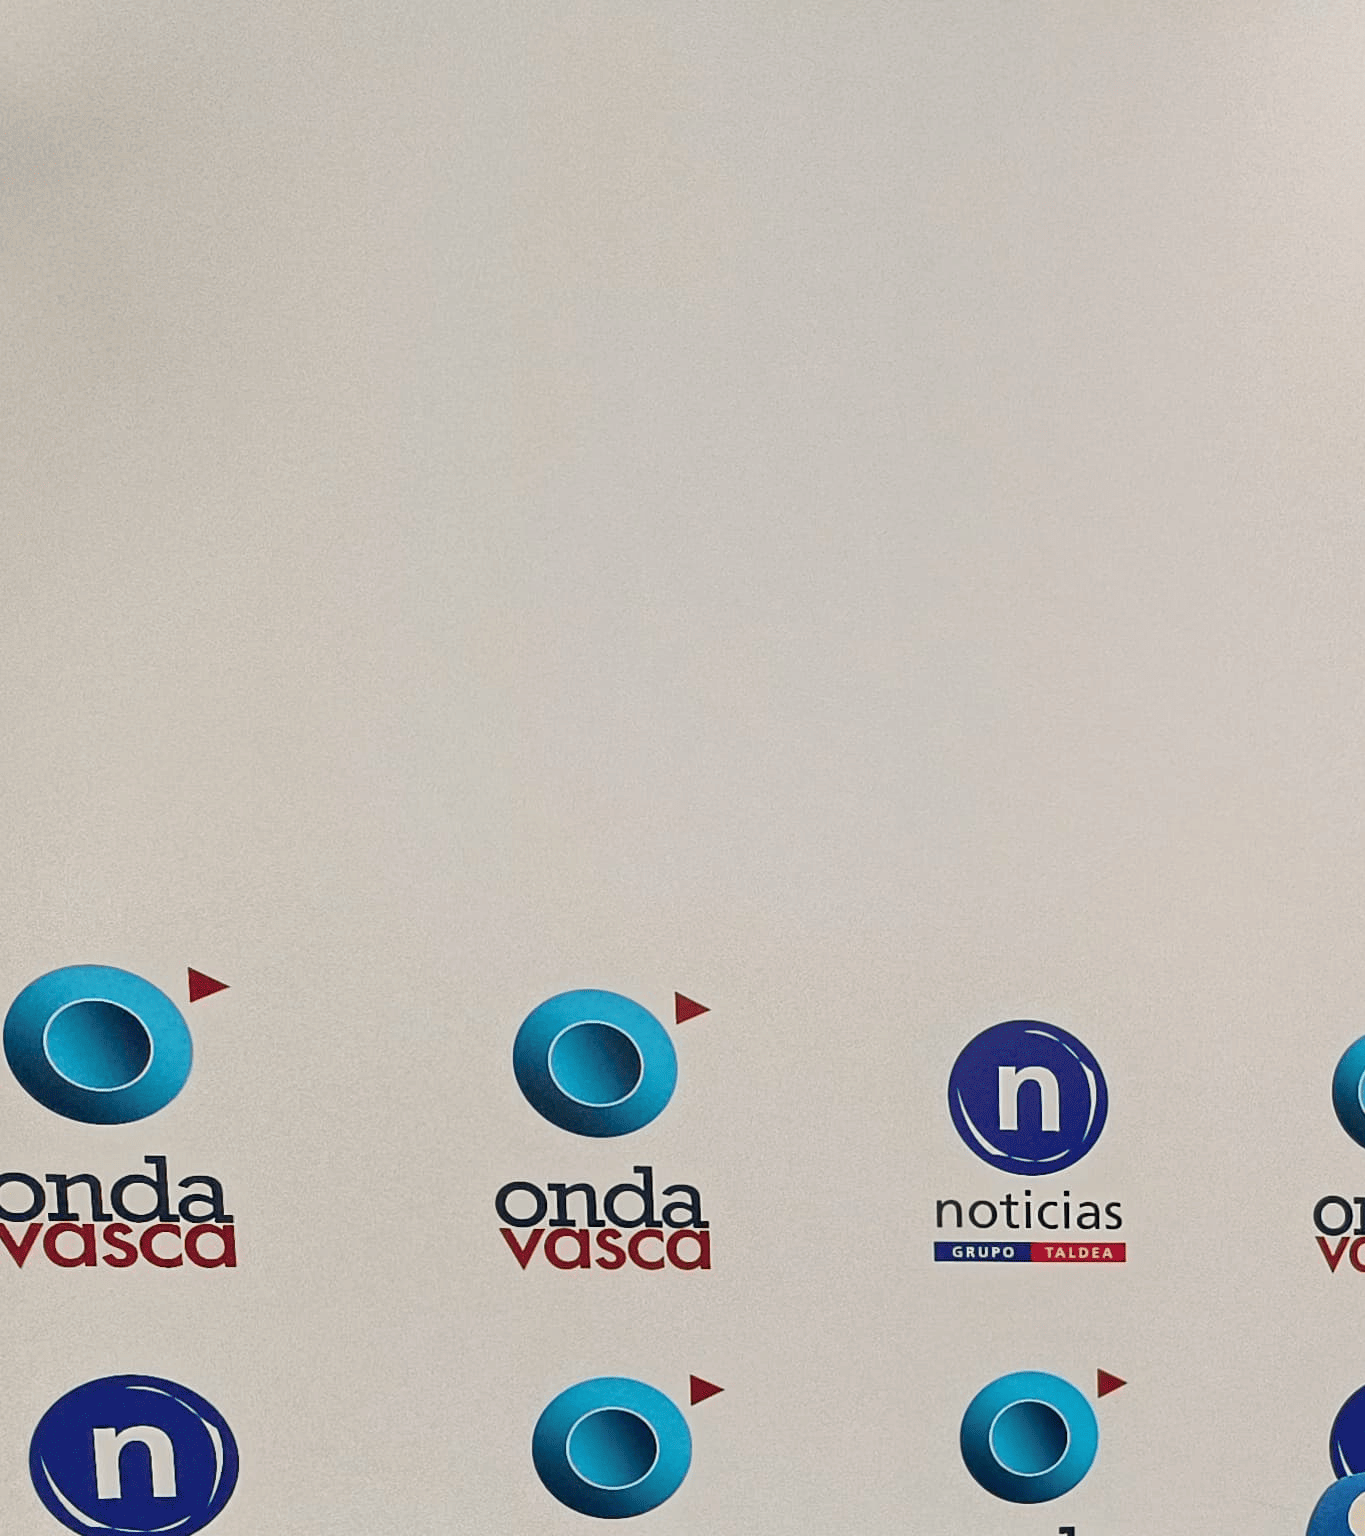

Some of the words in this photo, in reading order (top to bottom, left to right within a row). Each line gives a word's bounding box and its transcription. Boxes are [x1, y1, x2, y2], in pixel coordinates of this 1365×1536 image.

[999, 1067, 1059, 1131] n
[0, 1156, 234, 1223] onda
[495, 1166, 709, 1228] onda
[937, 1190, 1122, 1229] noticias
[0, 1223, 236, 1267] vasca
[500, 1228, 712, 1270] vasca
[953, 1247, 1014, 1257] GRUPO
[1045, 1247, 1112, 1258] TALDEA
[94, 1426, 176, 1499] n
